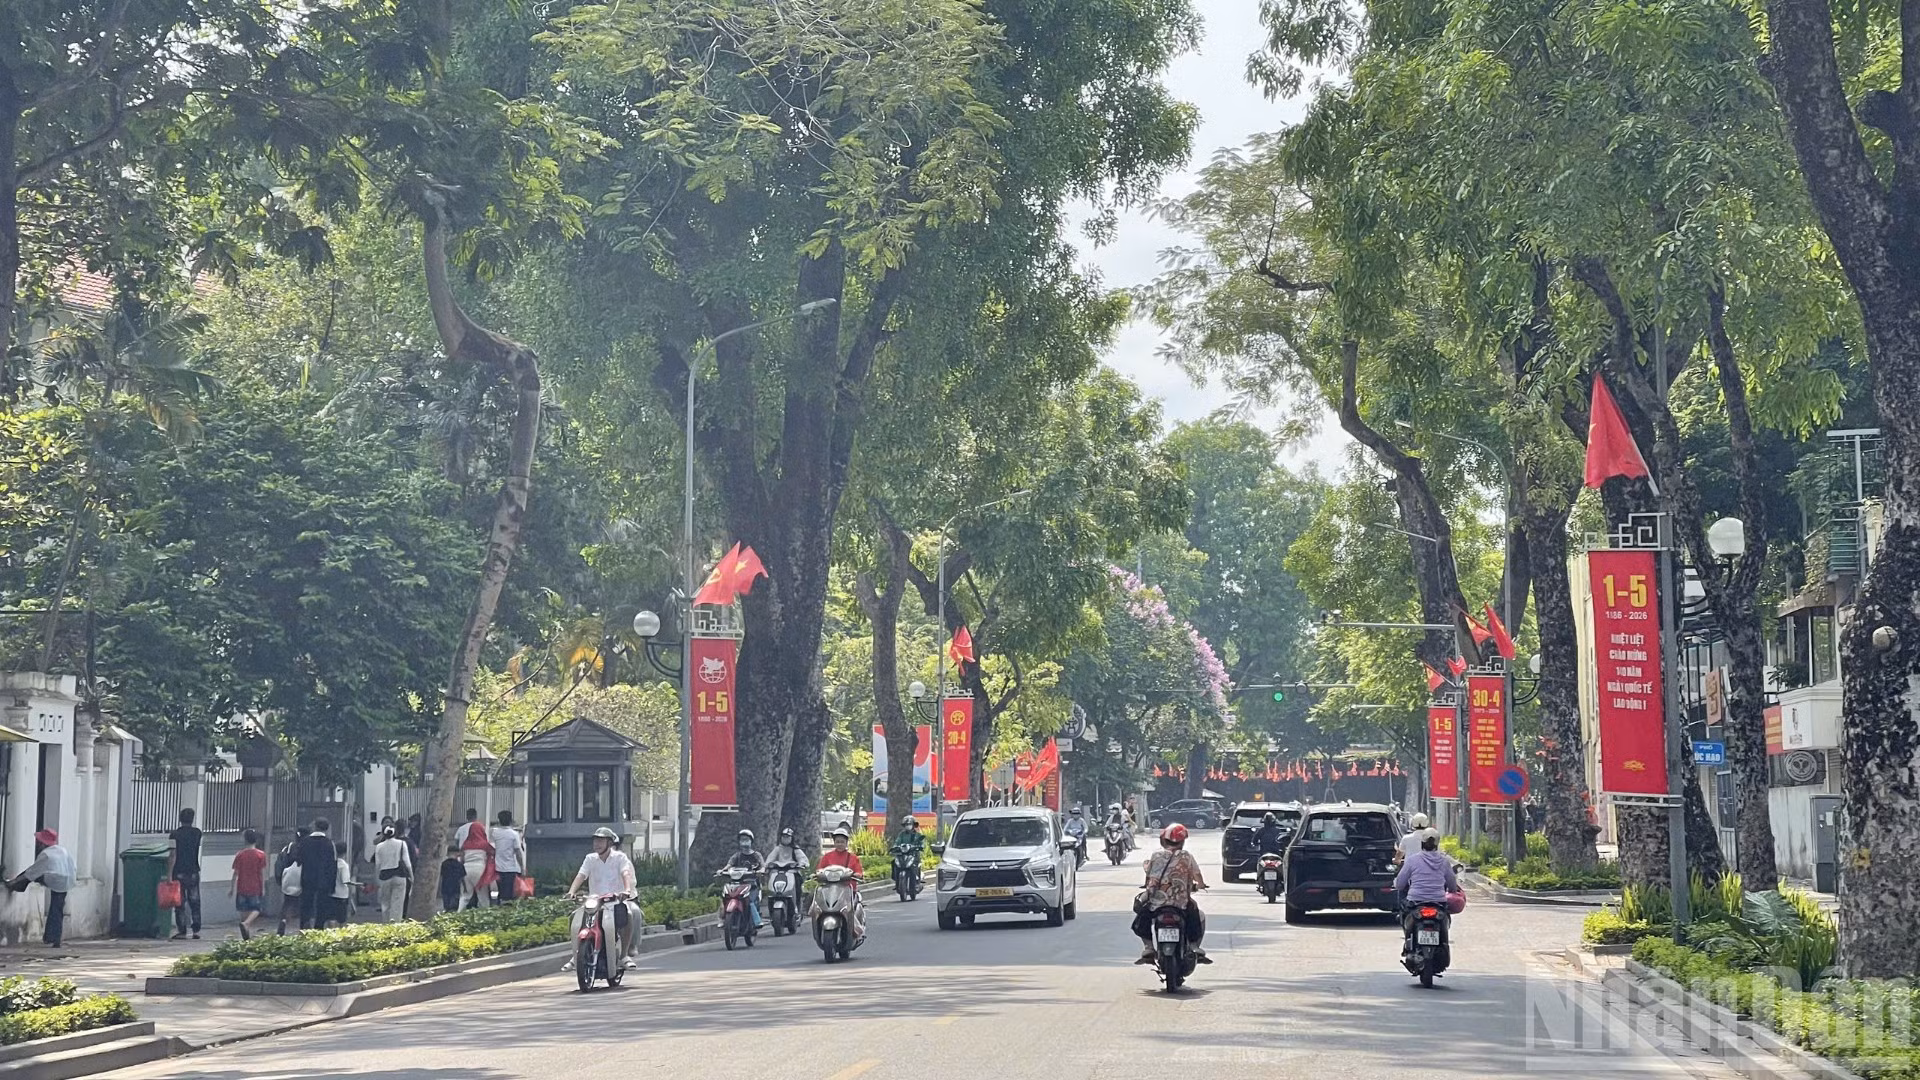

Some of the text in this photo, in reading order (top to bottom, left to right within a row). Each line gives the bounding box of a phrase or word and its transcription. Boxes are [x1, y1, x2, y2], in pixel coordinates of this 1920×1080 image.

[1603, 574, 1647, 608] 1-5
[1629, 611, 1648, 620] 2026
[697, 691, 728, 713] 1-5
[1473, 689, 1500, 707] 30-4
[1434, 717, 1452, 731] 1-5
